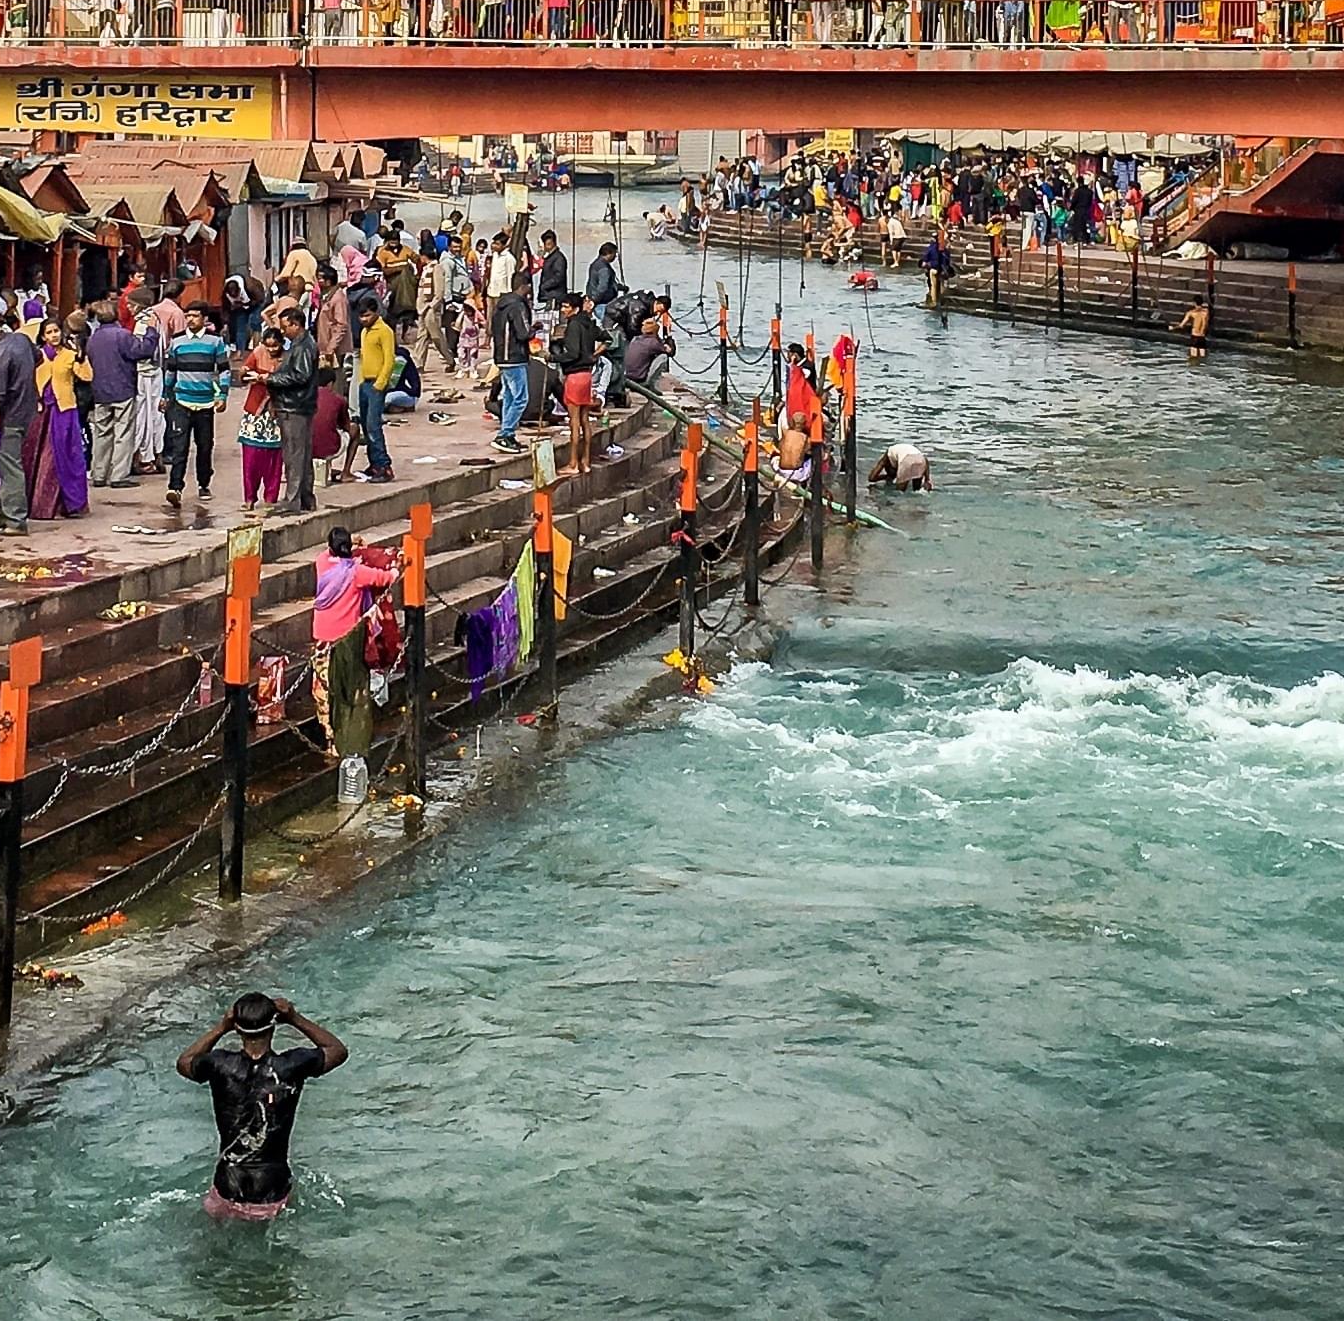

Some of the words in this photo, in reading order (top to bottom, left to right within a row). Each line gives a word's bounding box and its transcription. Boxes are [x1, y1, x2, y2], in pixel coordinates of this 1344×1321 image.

[16, 77, 64, 98] श्री
[71, 76, 159, 98] गंगा
[169, 84, 255, 99] सभा
[16, 101, 100, 124] (रजि.)
[116, 101, 235, 127] हरिद्वार
